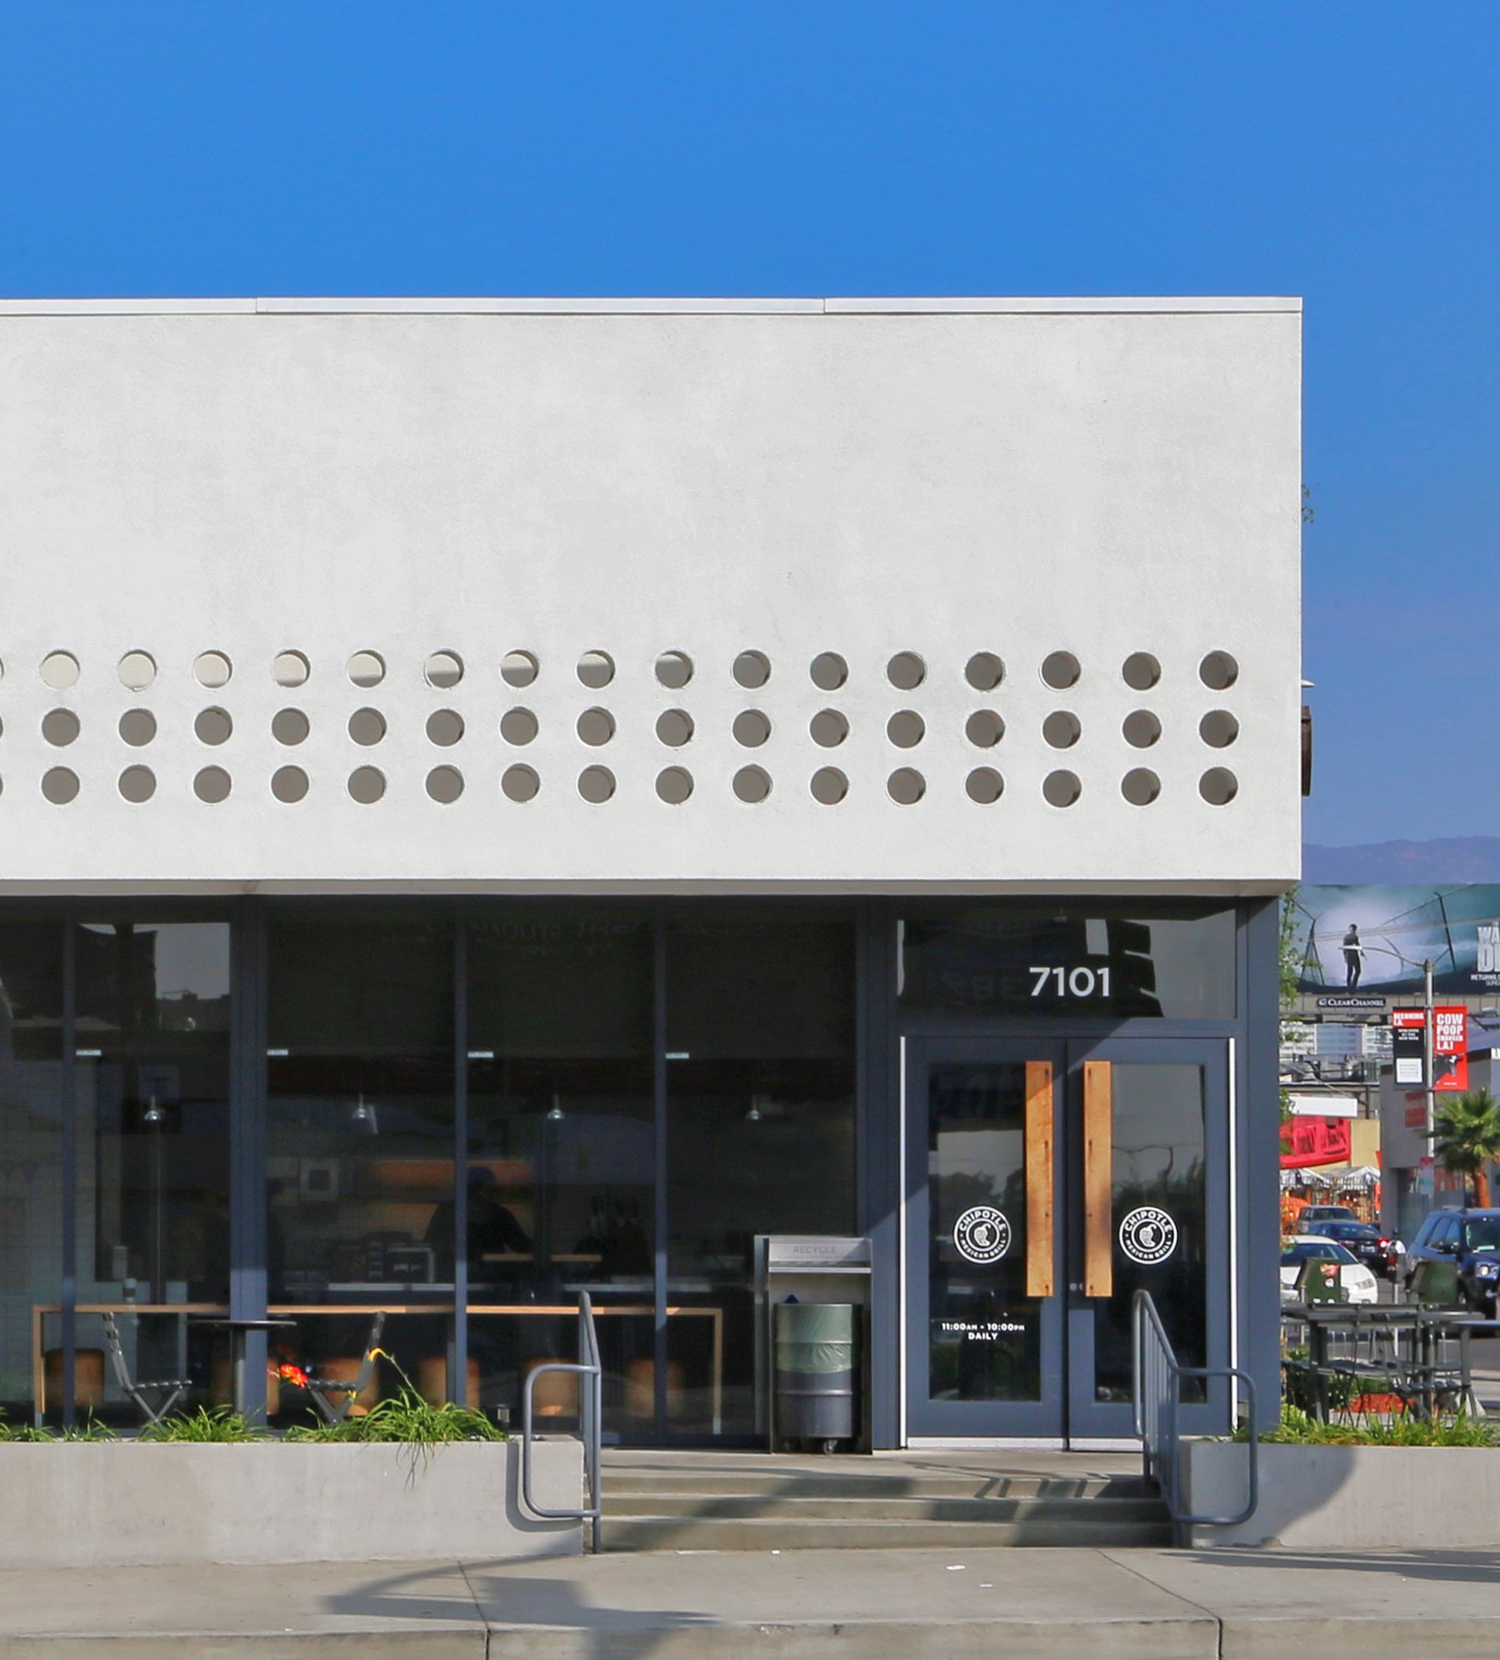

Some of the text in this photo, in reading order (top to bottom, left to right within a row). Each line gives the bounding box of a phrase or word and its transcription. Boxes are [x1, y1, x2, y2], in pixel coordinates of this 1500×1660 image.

[1029, 967, 1110, 997] 7101
[1436, 1013, 1464, 1025] COW
[1436, 1025, 1464, 1035] POOP
[959, 1210, 1007, 1232] CHIPOTLE
[1124, 1211, 1173, 1232] CHIPOTLE
[793, 1246, 837, 1255] RECYCLE
[960, 1239, 1006, 1259] MEXICAN GRILL
[1125, 1240, 1172, 1259] MEXICAN GRILL
[941, 1323, 978, 1331] 11:00AM
[986, 1323, 1025, 1331] 10:00PM
[968, 1332, 998, 1340] DAILY
